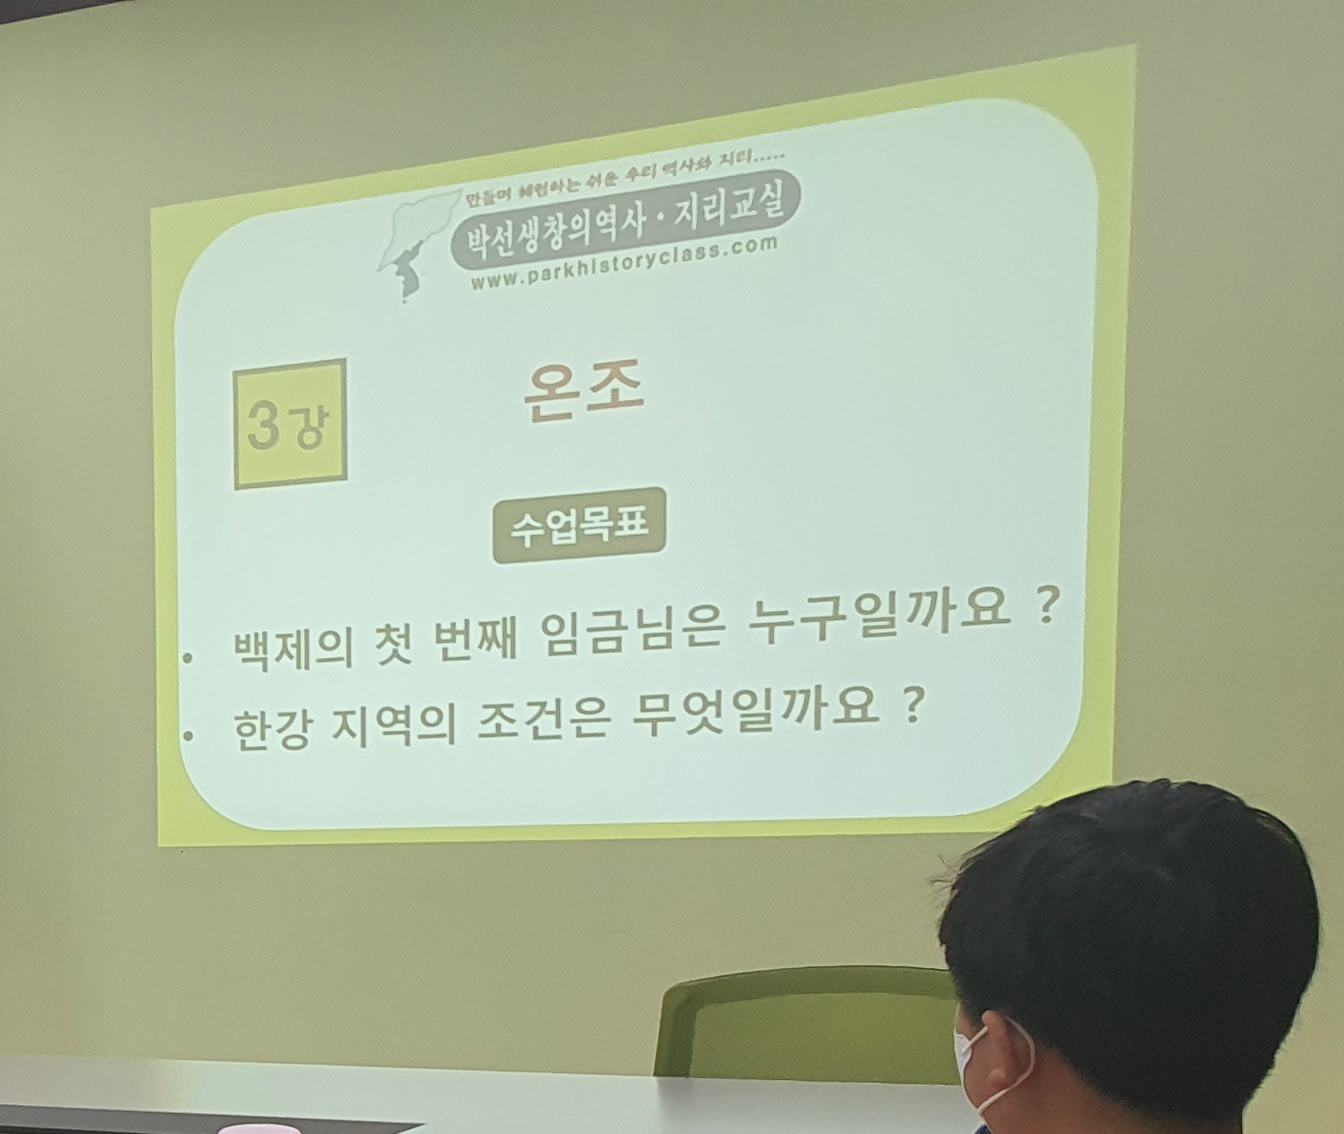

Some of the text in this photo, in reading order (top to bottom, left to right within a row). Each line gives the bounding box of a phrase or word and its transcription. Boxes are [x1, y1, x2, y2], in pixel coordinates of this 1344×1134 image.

[585, 171, 619, 188] 쉬운
[625, 163, 657, 182] 우리
[662, 155, 712, 176] 역사와
[470, 235, 779, 291] www.parkhistoryclass.com
[523, 358, 645, 423] 온조
[510, 504, 650, 549] 수업목표
[233, 626, 354, 673] 백제의
[374, 621, 413, 666] 첫
[434, 615, 517, 662] 번째
[540, 602, 727, 657] 임금님은
[748, 585, 1012, 645] 누구일까요
[233, 707, 315, 752] 한강
[331, 701, 456, 749] 지역의
[477, 696, 613, 741] 조건은
[632, 683, 881, 738] 무엇일까요
